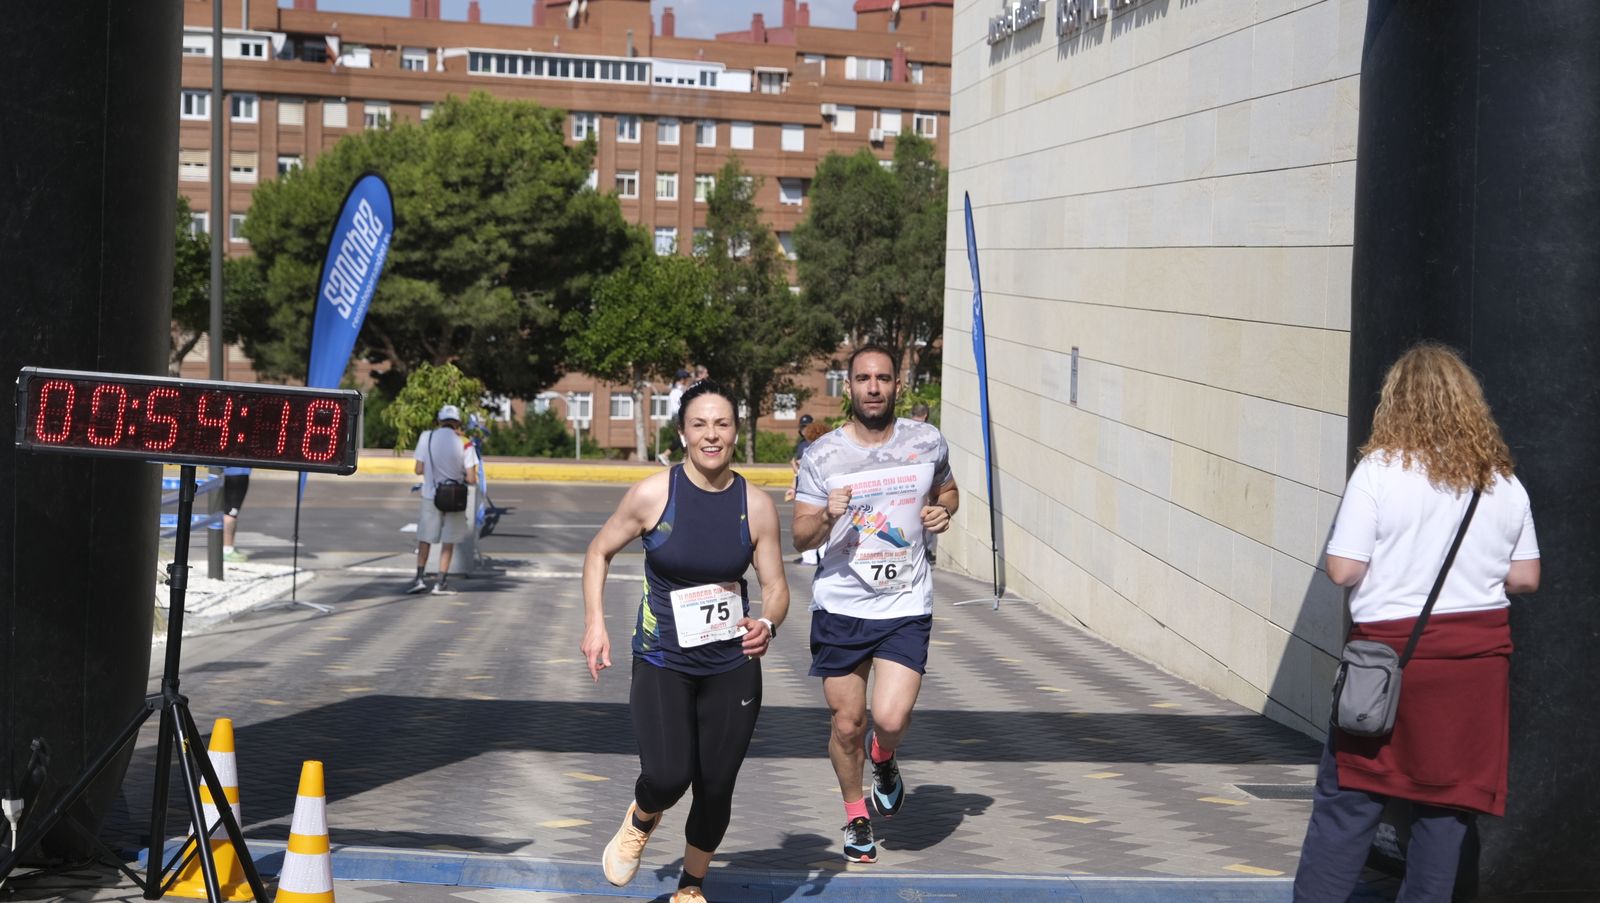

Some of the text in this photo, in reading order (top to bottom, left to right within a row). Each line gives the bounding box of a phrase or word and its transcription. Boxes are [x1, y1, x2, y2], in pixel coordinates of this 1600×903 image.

[35, 380, 341, 461] 00:54:18
[870, 563, 898, 581] 76
[699, 601, 730, 625] 75
